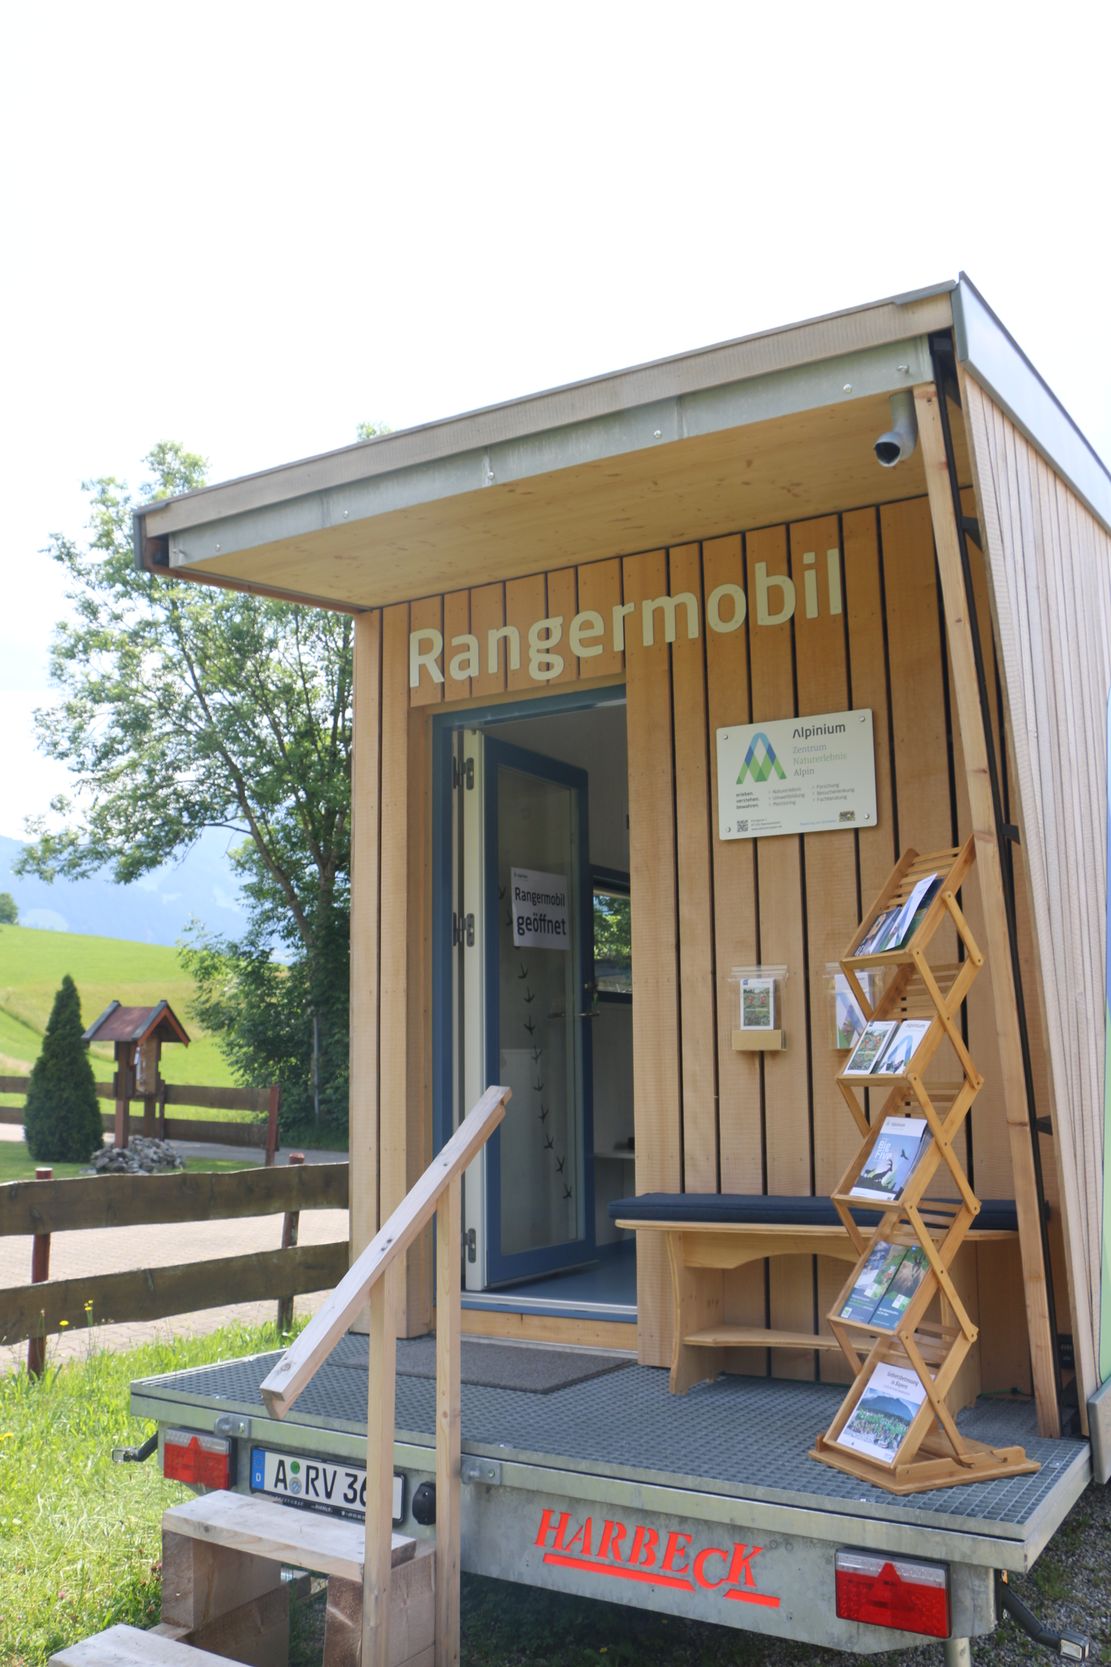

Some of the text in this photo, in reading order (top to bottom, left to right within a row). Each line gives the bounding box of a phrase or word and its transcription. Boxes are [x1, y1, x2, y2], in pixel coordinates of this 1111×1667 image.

[409, 548, 842, 688] Rangermobil
[792, 723, 846, 740] Alpinium
[792, 744, 827, 754] Zentrum
[793, 768, 815, 777] Alpin
[514, 887, 566, 907] Rangermobil
[516, 912, 567, 936] geöffnet
[274, 1459, 288, 1491] A
[305, 1465, 337, 1499] RV
[534, 1509, 766, 1590] HARBECK
